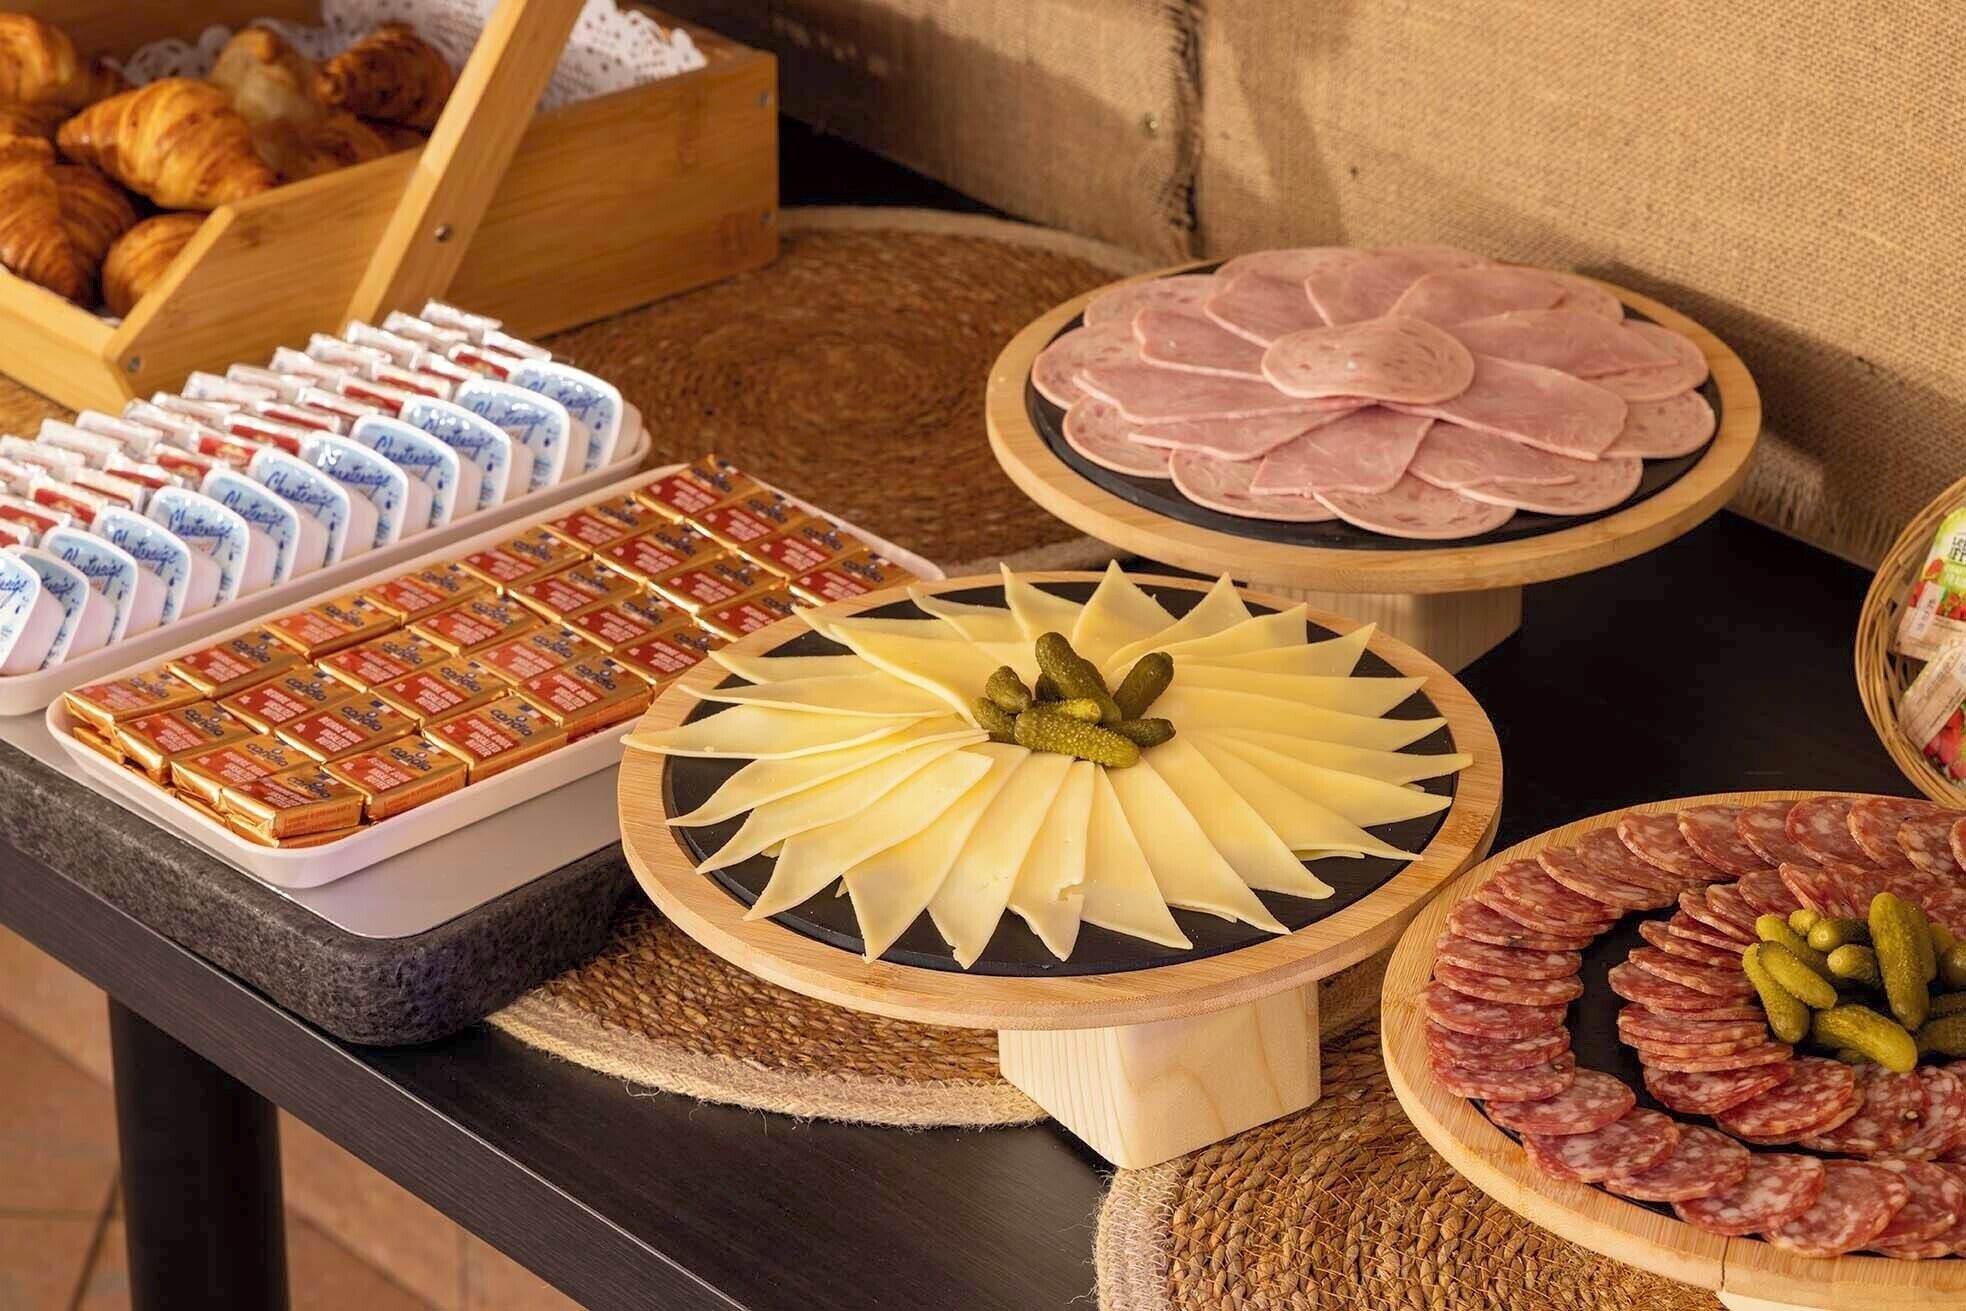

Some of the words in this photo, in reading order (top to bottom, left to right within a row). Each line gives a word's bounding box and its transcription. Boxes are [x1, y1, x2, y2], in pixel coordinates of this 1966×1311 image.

[341, 706, 383, 732] candia
[490, 708, 532, 737] candia
[390, 747, 432, 772] candia
